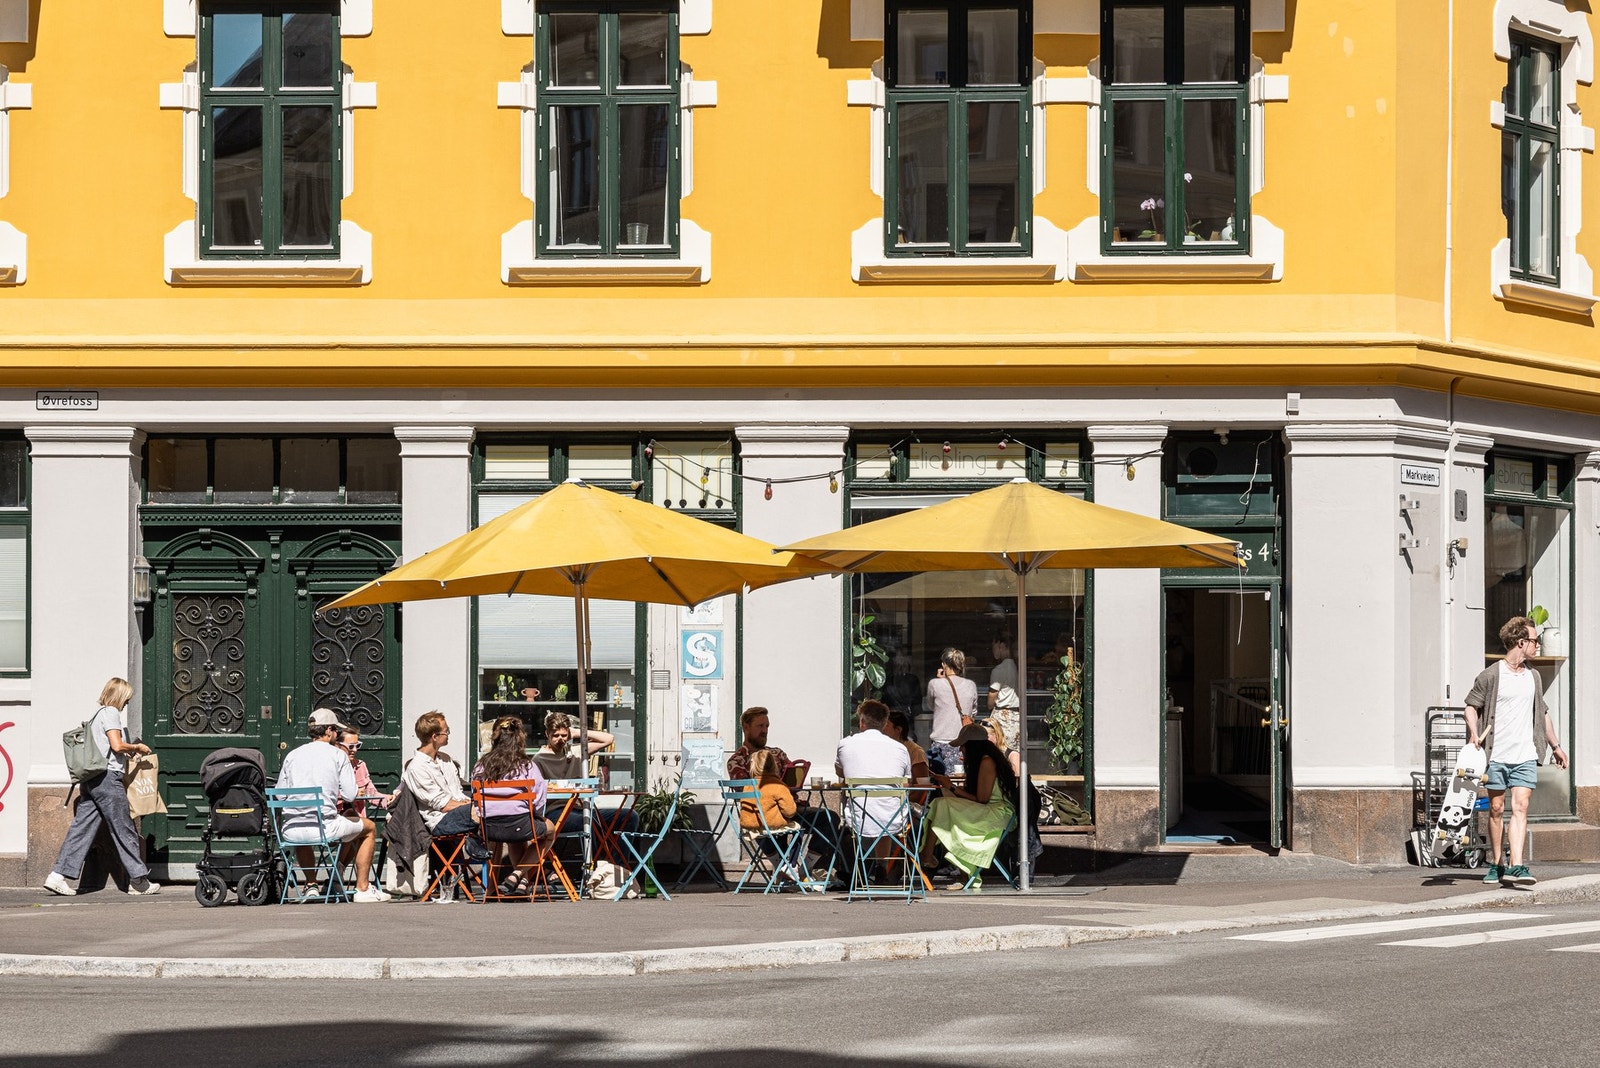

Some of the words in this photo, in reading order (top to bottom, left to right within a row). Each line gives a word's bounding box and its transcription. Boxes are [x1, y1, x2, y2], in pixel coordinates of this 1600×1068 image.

[43, 396, 92, 405] Øvrefoss
[921, 447, 987, 475] liebling
[1405, 469, 1435, 481] Markveien
[1495, 463, 1525, 491] iebling
[1258, 542, 1270, 561] 4
[686, 632, 717, 676] S
[1466, 791, 1474, 807] enjoi
